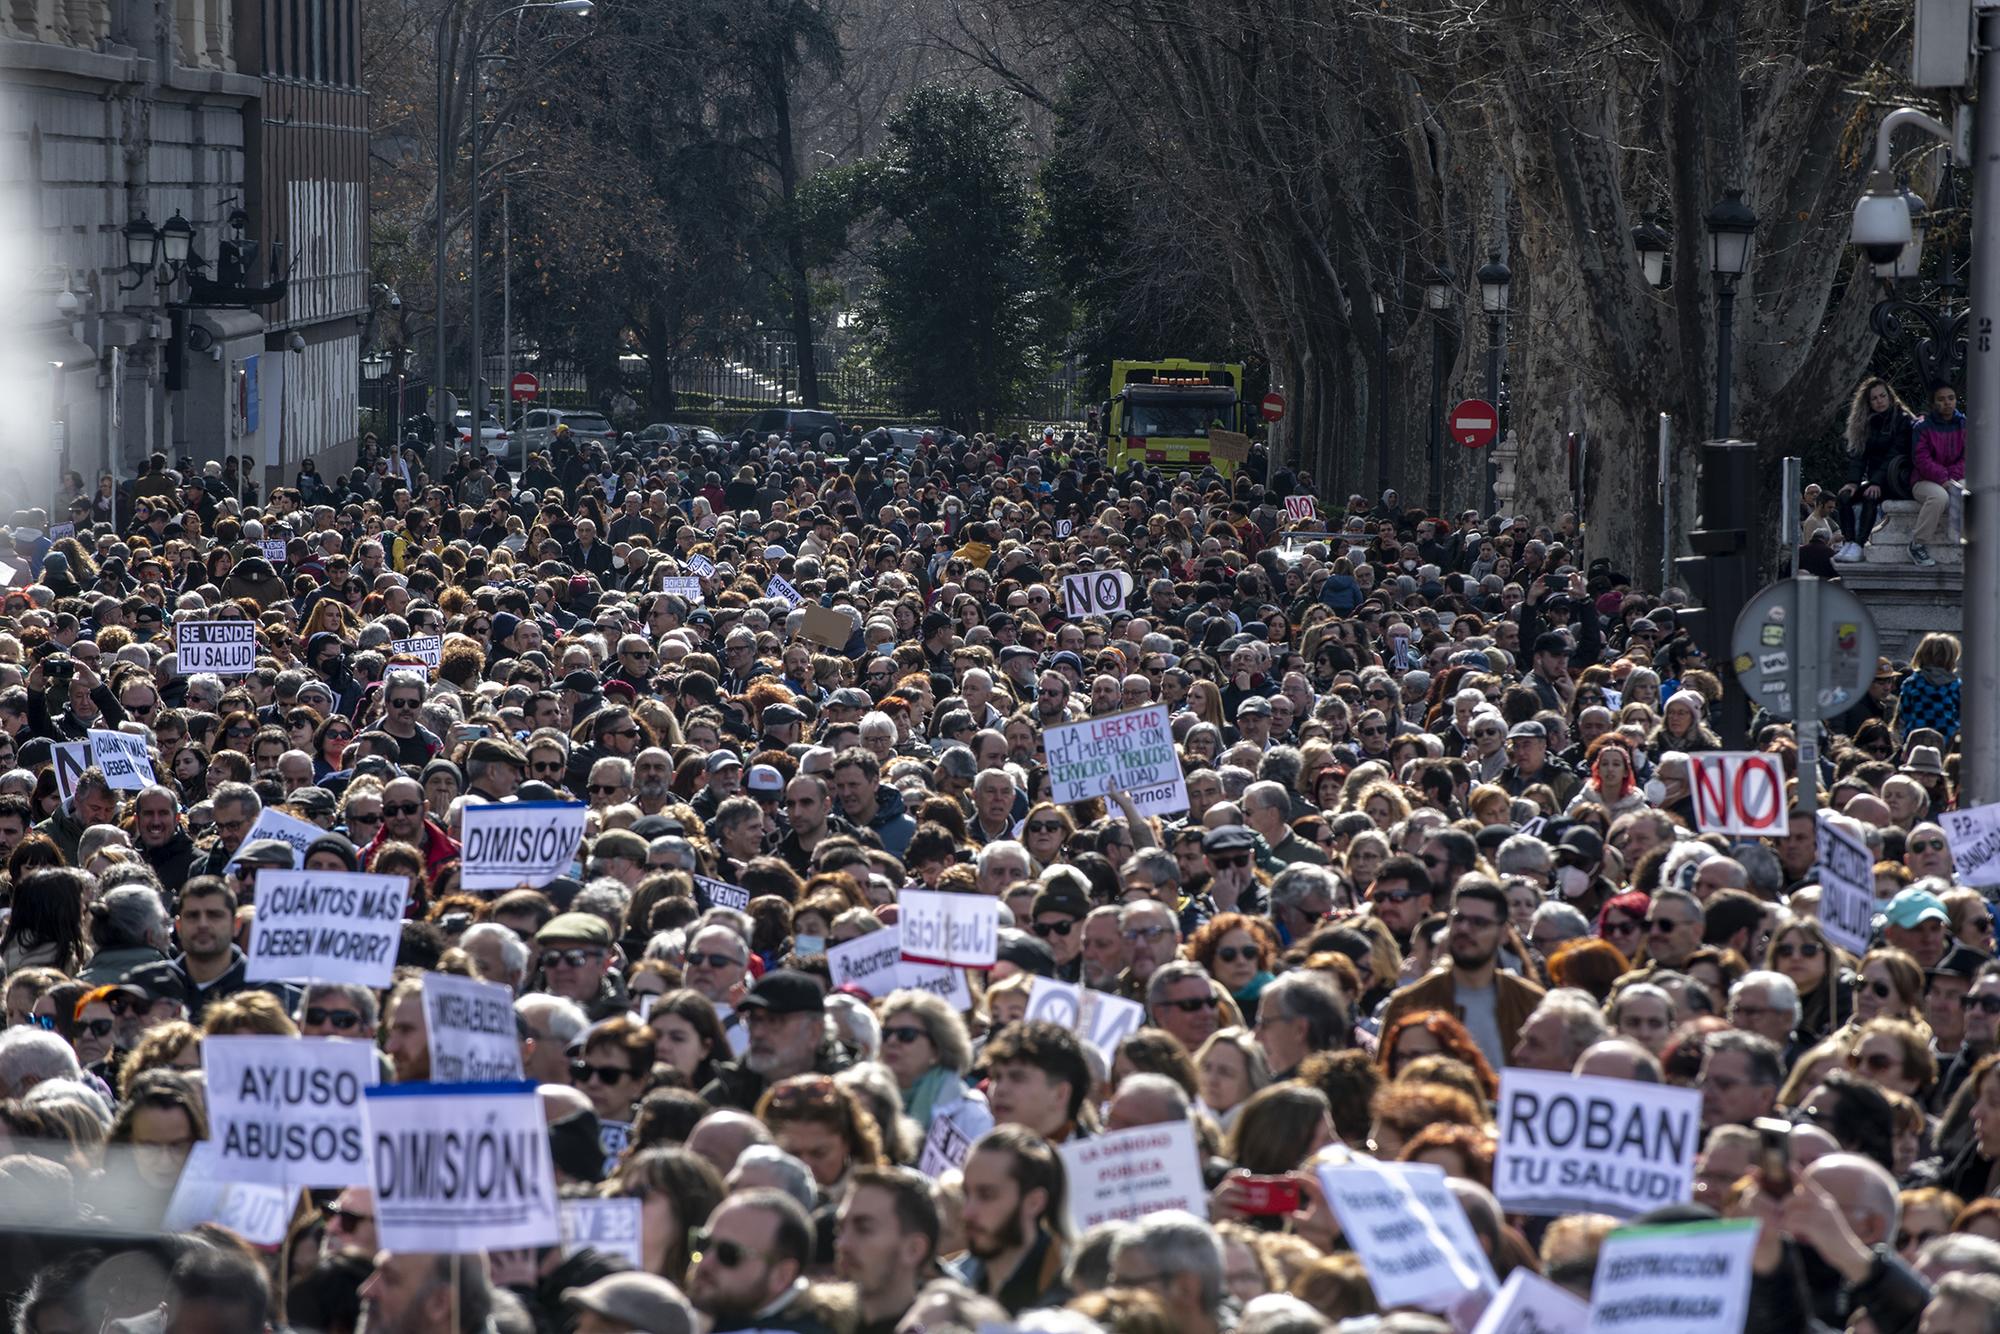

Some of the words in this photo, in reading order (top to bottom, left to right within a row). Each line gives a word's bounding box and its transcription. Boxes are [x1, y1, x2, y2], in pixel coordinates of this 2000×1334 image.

[1287, 498, 1313, 520] NO
[1058, 521, 1071, 537] O
[267, 540, 286, 550] VENDE
[1066, 573, 1122, 615] NO
[181, 626, 200, 641] SE
[205, 626, 253, 641] VENDE
[394, 643, 405, 654] SE
[407, 638, 439, 652] VENDE
[182, 645, 200, 667] TU
[204, 644, 252, 666] SALUD
[1062, 728, 1080, 746] LA
[1092, 712, 1160, 740] LIBERTAD
[130, 739, 147, 758] MÁS
[1050, 742, 1073, 766] DEL
[1078, 737, 1133, 761] PUEBLO
[1140, 728, 1166, 746] SON
[104, 759, 135, 777] DEBEN
[1052, 758, 1111, 784] SERVICIOS
[1068, 780, 1088, 799] DE
[1692, 757, 1781, 829] NO
[465, 817, 582, 863] DIMISIÓN!
[259, 880, 357, 924] ¿CUÁNTOS
[359, 884, 400, 922] MÁS
[709, 884, 747, 910] VENDE
[257, 927, 314, 957] DEBEN
[315, 929, 390, 963] MORIR?
[222, 1122, 362, 1163] ABUSOS
[1507, 1091, 1690, 1165] ROBAN
[375, 1111, 539, 1201] DIMISIÓN!
[1505, 1155, 1548, 1185] TU
[1559, 1158, 1682, 1202] SALUD!
